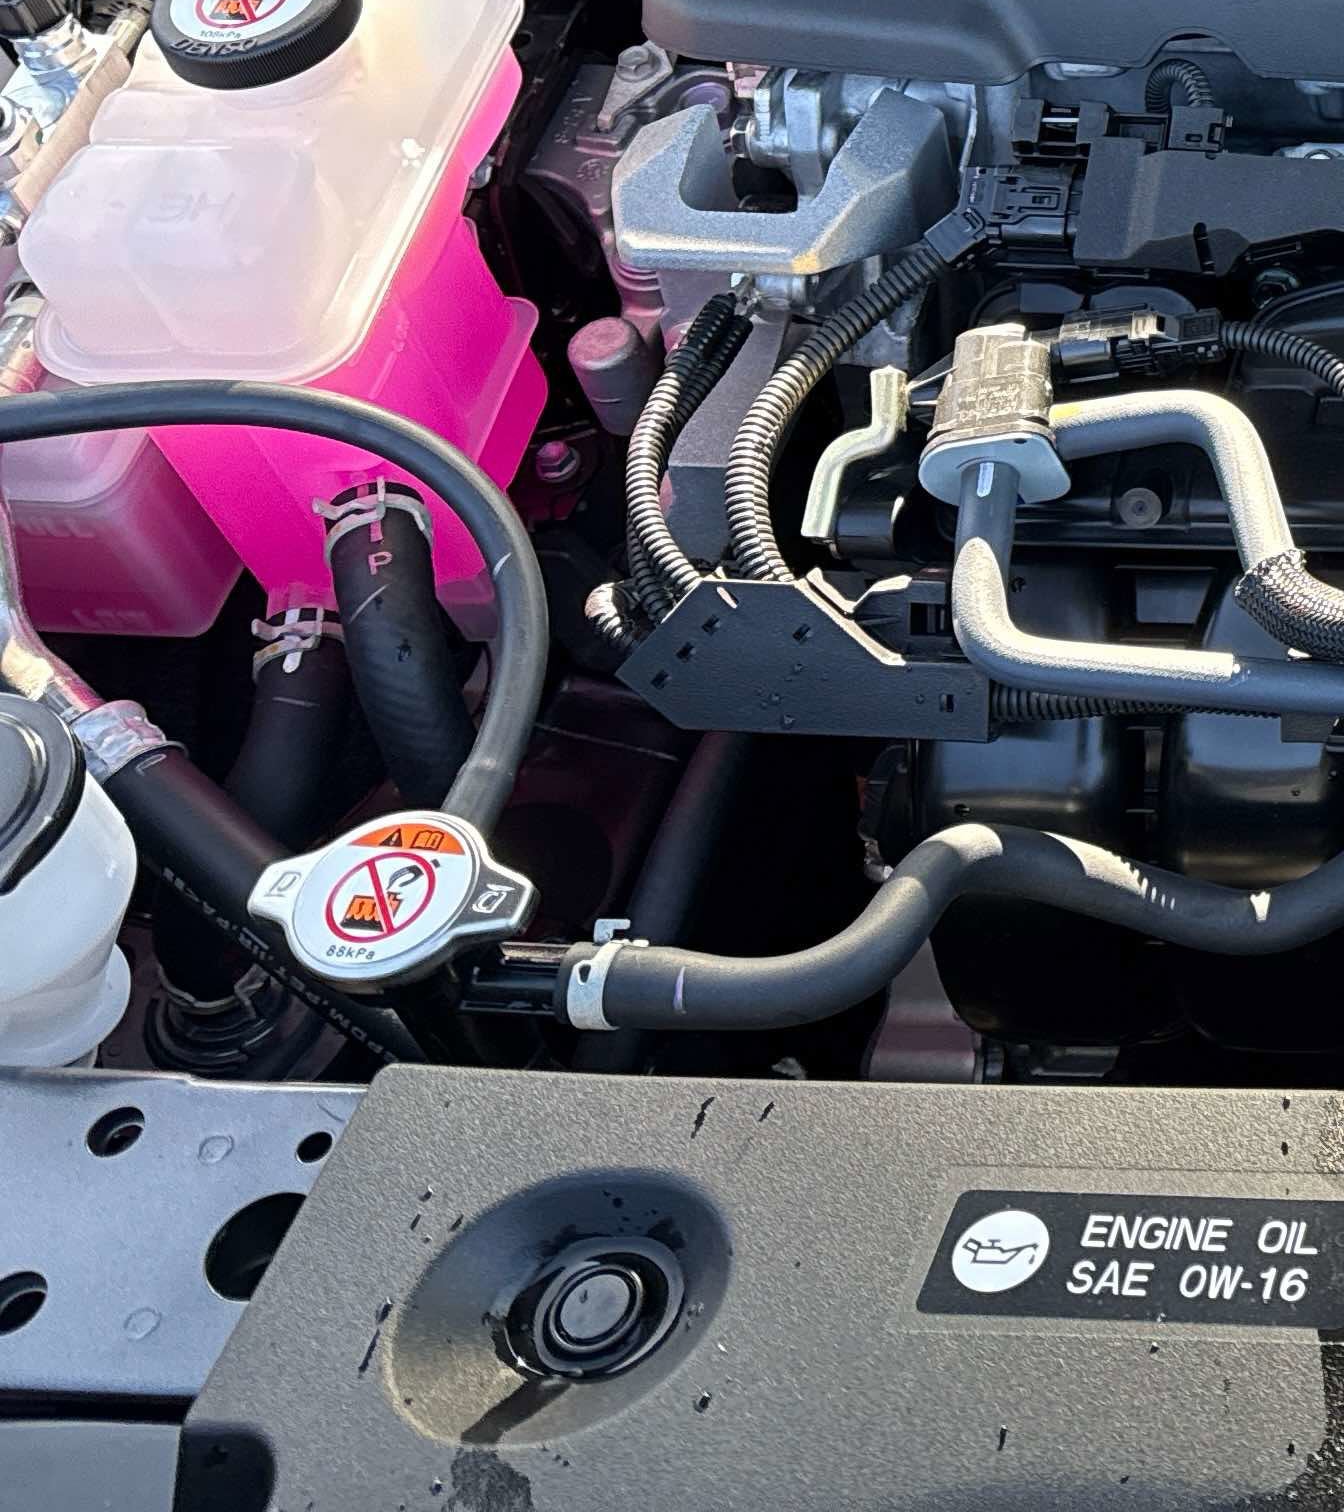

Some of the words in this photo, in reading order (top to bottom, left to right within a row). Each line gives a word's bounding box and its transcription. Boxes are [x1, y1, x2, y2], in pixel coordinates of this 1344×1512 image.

[169, 37, 258, 58] DENSO
[367, 551, 393, 576] P
[325, 943, 376, 961] 88kPa
[1079, 1213, 1234, 1253] ENGINE
[1256, 1220, 1319, 1256] OIL
[1065, 1260, 1156, 1298] SAE
[1178, 1265, 1309, 1303] 0W-16
